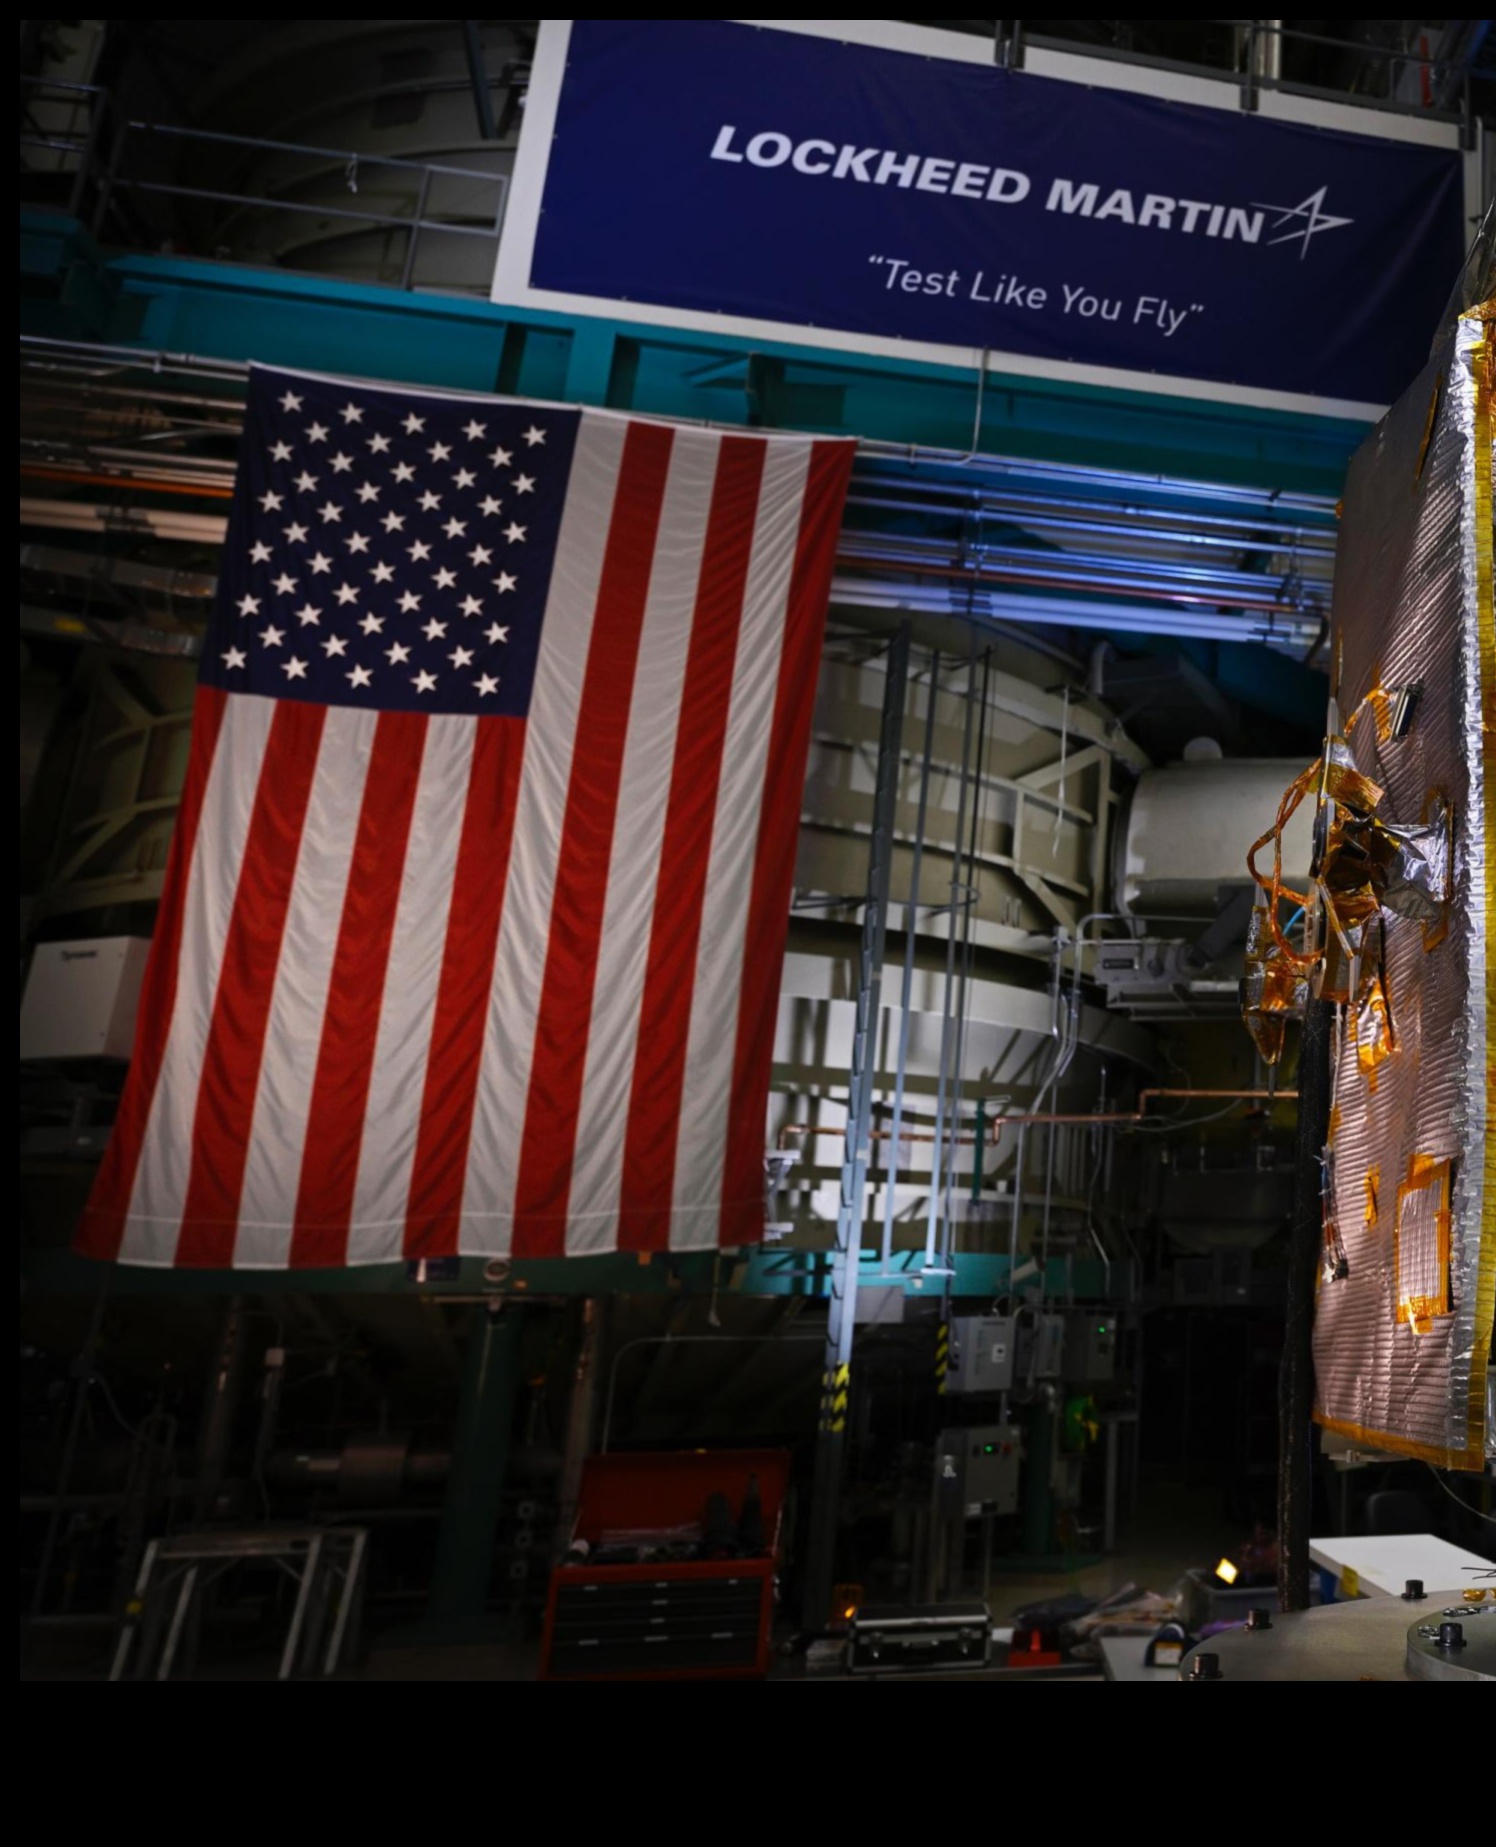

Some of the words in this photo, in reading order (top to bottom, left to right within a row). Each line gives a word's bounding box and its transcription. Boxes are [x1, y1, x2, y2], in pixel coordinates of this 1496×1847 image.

[709, 125, 1031, 204] LOCKHEED
[1044, 178, 1265, 243] MARTIN
[970, 271, 1048, 310] Like
[1060, 283, 1123, 321] You
